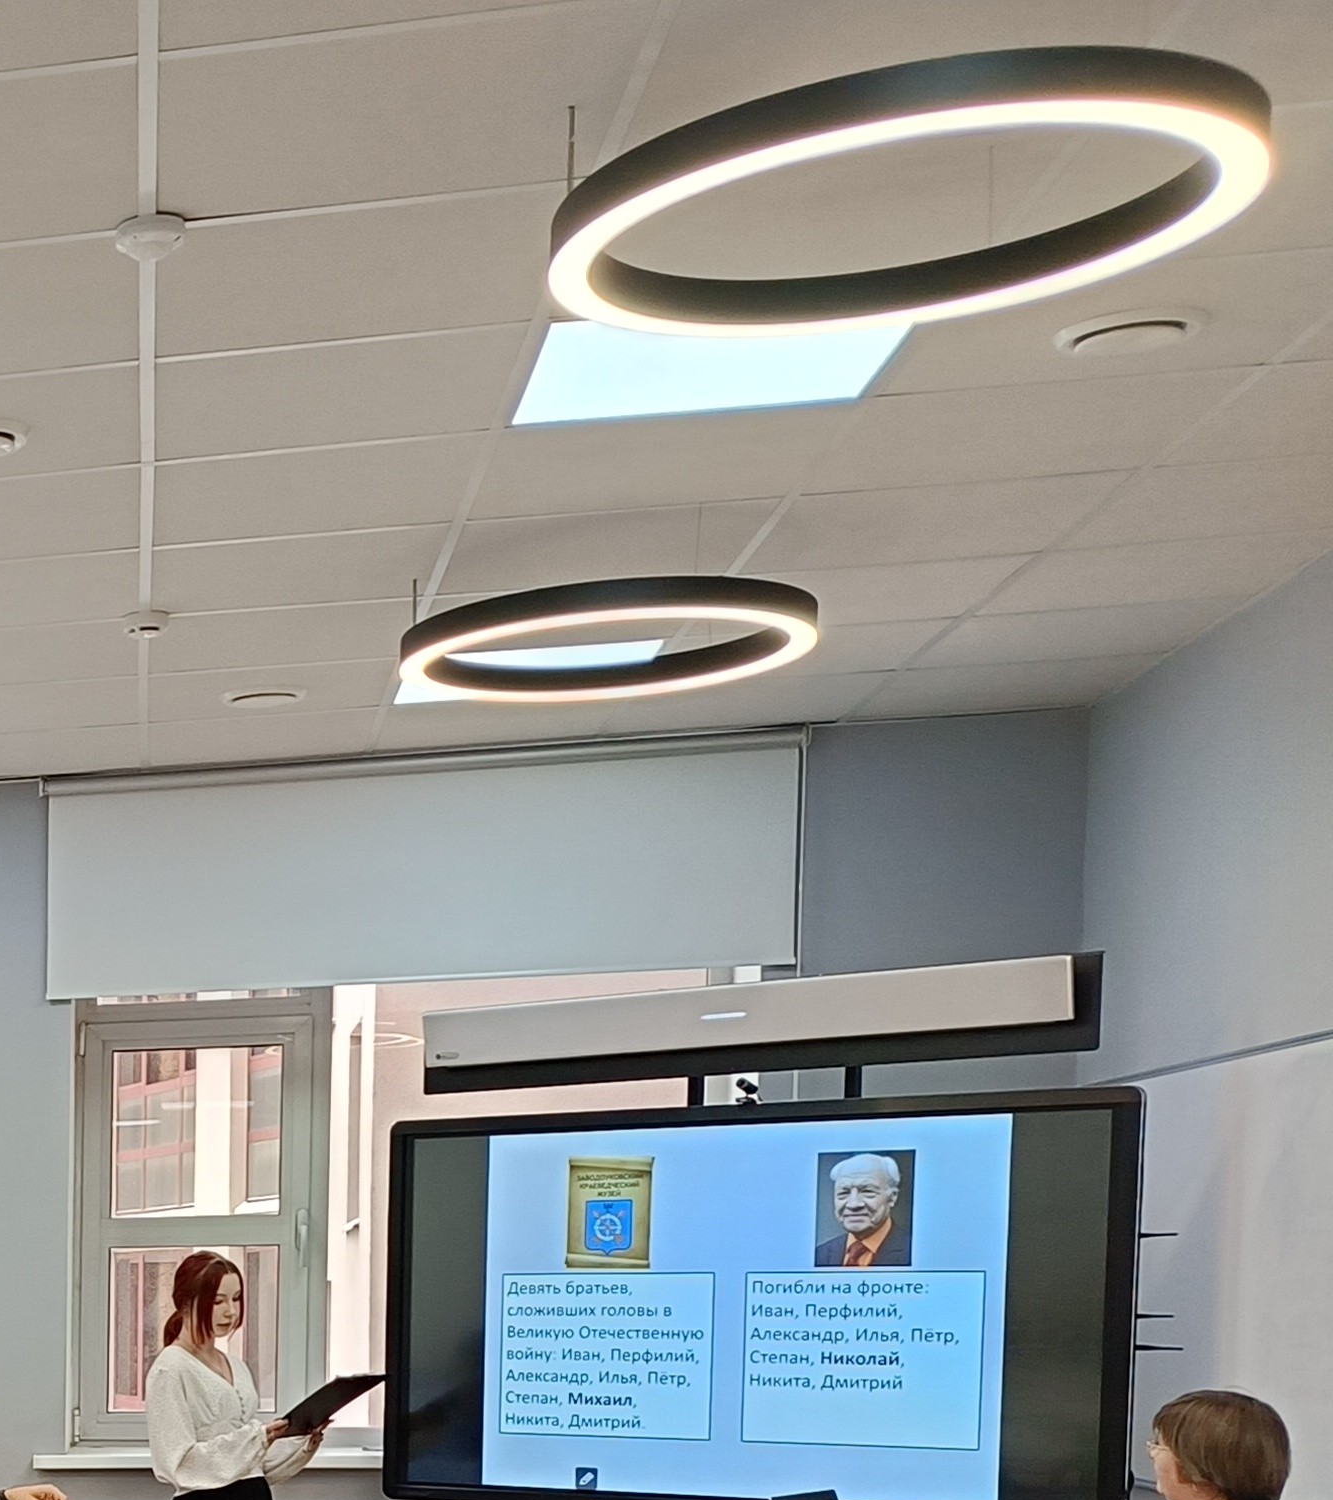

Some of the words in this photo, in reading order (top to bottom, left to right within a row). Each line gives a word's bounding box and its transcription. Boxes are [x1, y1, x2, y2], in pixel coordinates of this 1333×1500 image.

[507, 1281, 561, 1296] Девять
[565, 1280, 633, 1296] братьев,
[751, 1280, 826, 1294] Погибли
[831, 1282, 851, 1294] на
[857, 1280, 930, 1297] фронте:
[507, 1305, 596, 1317] сложивших
[600, 1305, 658, 1317] головы
[663, 1305, 672, 1317] в
[751, 1304, 800, 1320] Иван,
[805, 1304, 903, 1320] Перфилий,
[507, 1325, 574, 1341] Великую
[579, 1326, 704, 1341] Отечественную
[750, 1327, 850, 1344] Александр,
[855, 1328, 905, 1344] Илья,
[911, 1328, 960, 1346] Пётр,
[506, 1347, 557, 1363] войну:
[561, 1348, 605, 1363] Иван,
[610, 1348, 700, 1365] Перфилий,
[750, 1350, 815, 1367] Степан,
[820, 1351, 905, 1368] Николай,
[505, 1369, 593, 1386] Александр,
[598, 1370, 642, 1386] Илья,
[647, 1371, 691, 1388] Пётр,
[749, 1374, 816, 1390] Никита,
[820, 1374, 903, 1391] Дмитрий
[505, 1390, 563, 1407] Степан,
[568, 1392, 637, 1409] Михаил,
[505, 1413, 564, 1429] Никита,
